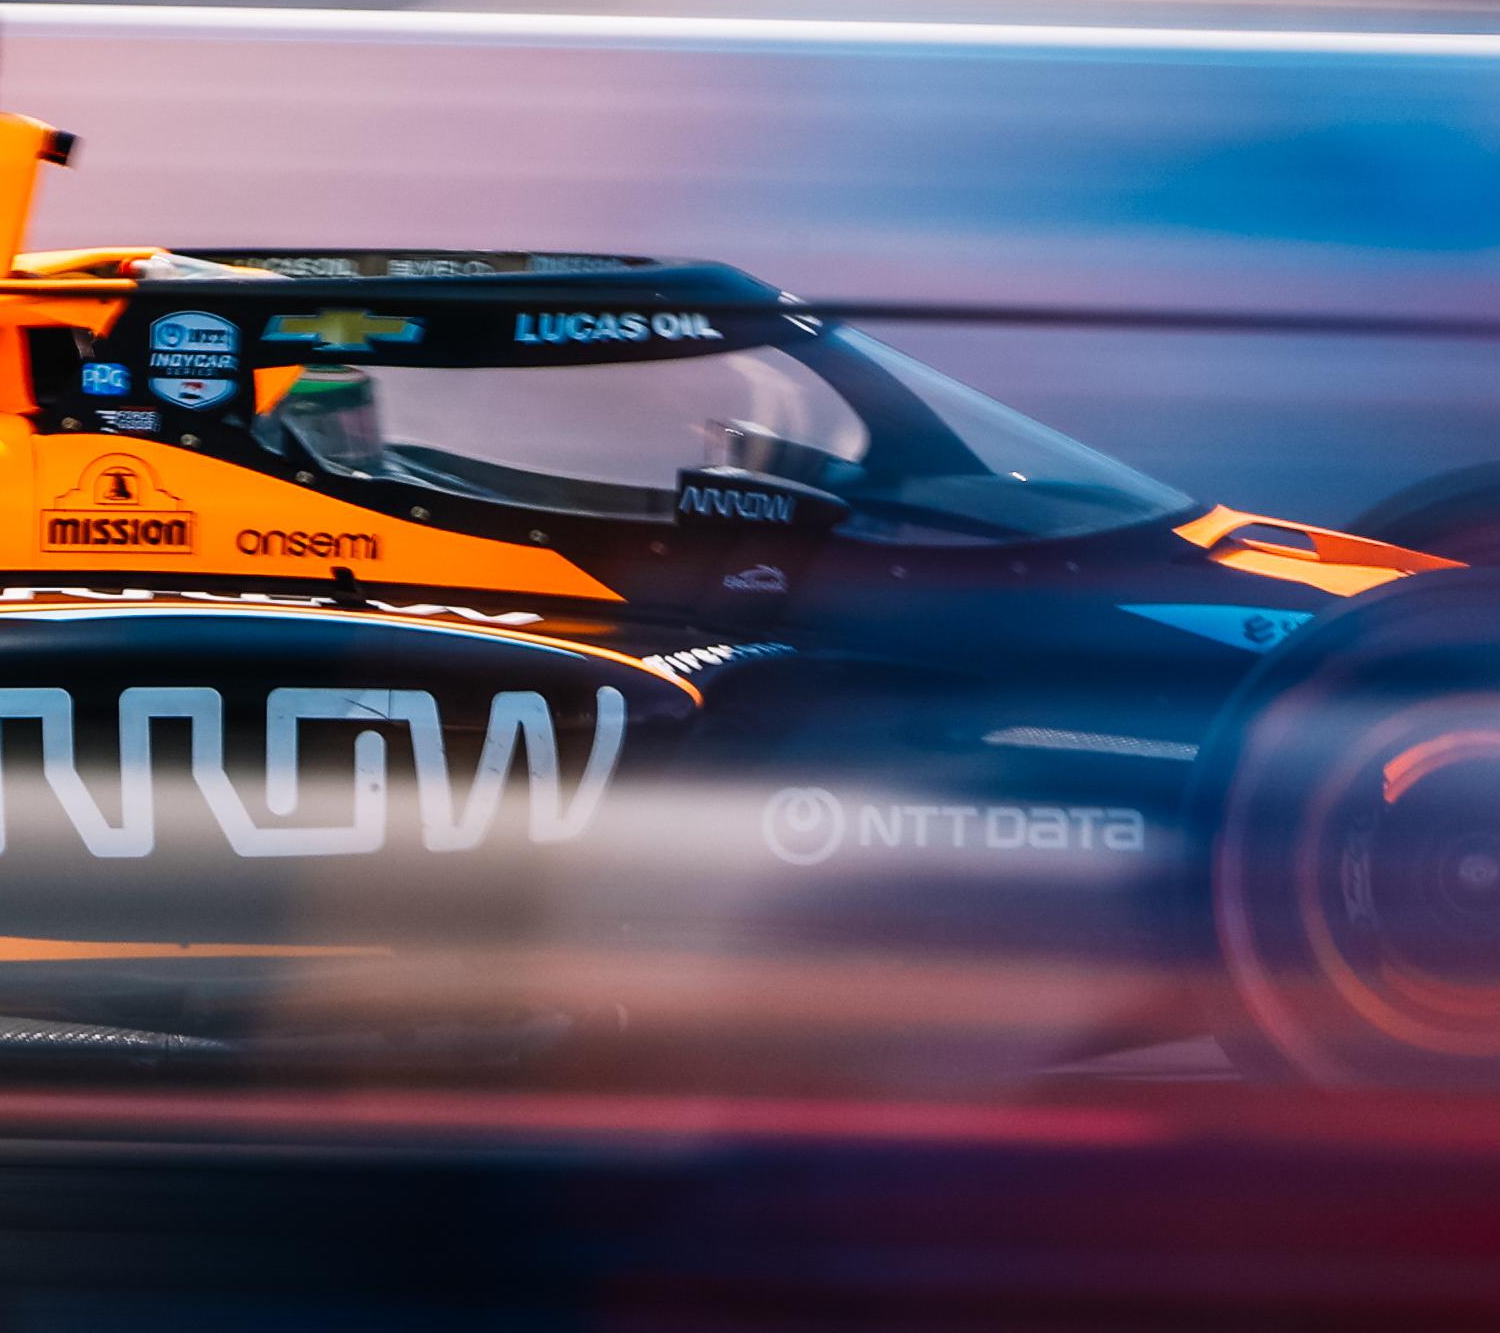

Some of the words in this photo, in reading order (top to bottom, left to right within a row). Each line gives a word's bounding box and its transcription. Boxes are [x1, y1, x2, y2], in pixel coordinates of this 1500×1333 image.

[514, 314, 649, 343] LUCAS
[650, 313, 723, 340] OIL
[151, 352, 240, 370] INDYCAR
[83, 364, 131, 391] PPG
[679, 485, 793, 523] ARROW
[49, 518, 186, 545] mission
[237, 529, 377, 559] onsemi
[858, 804, 977, 849] NTT
